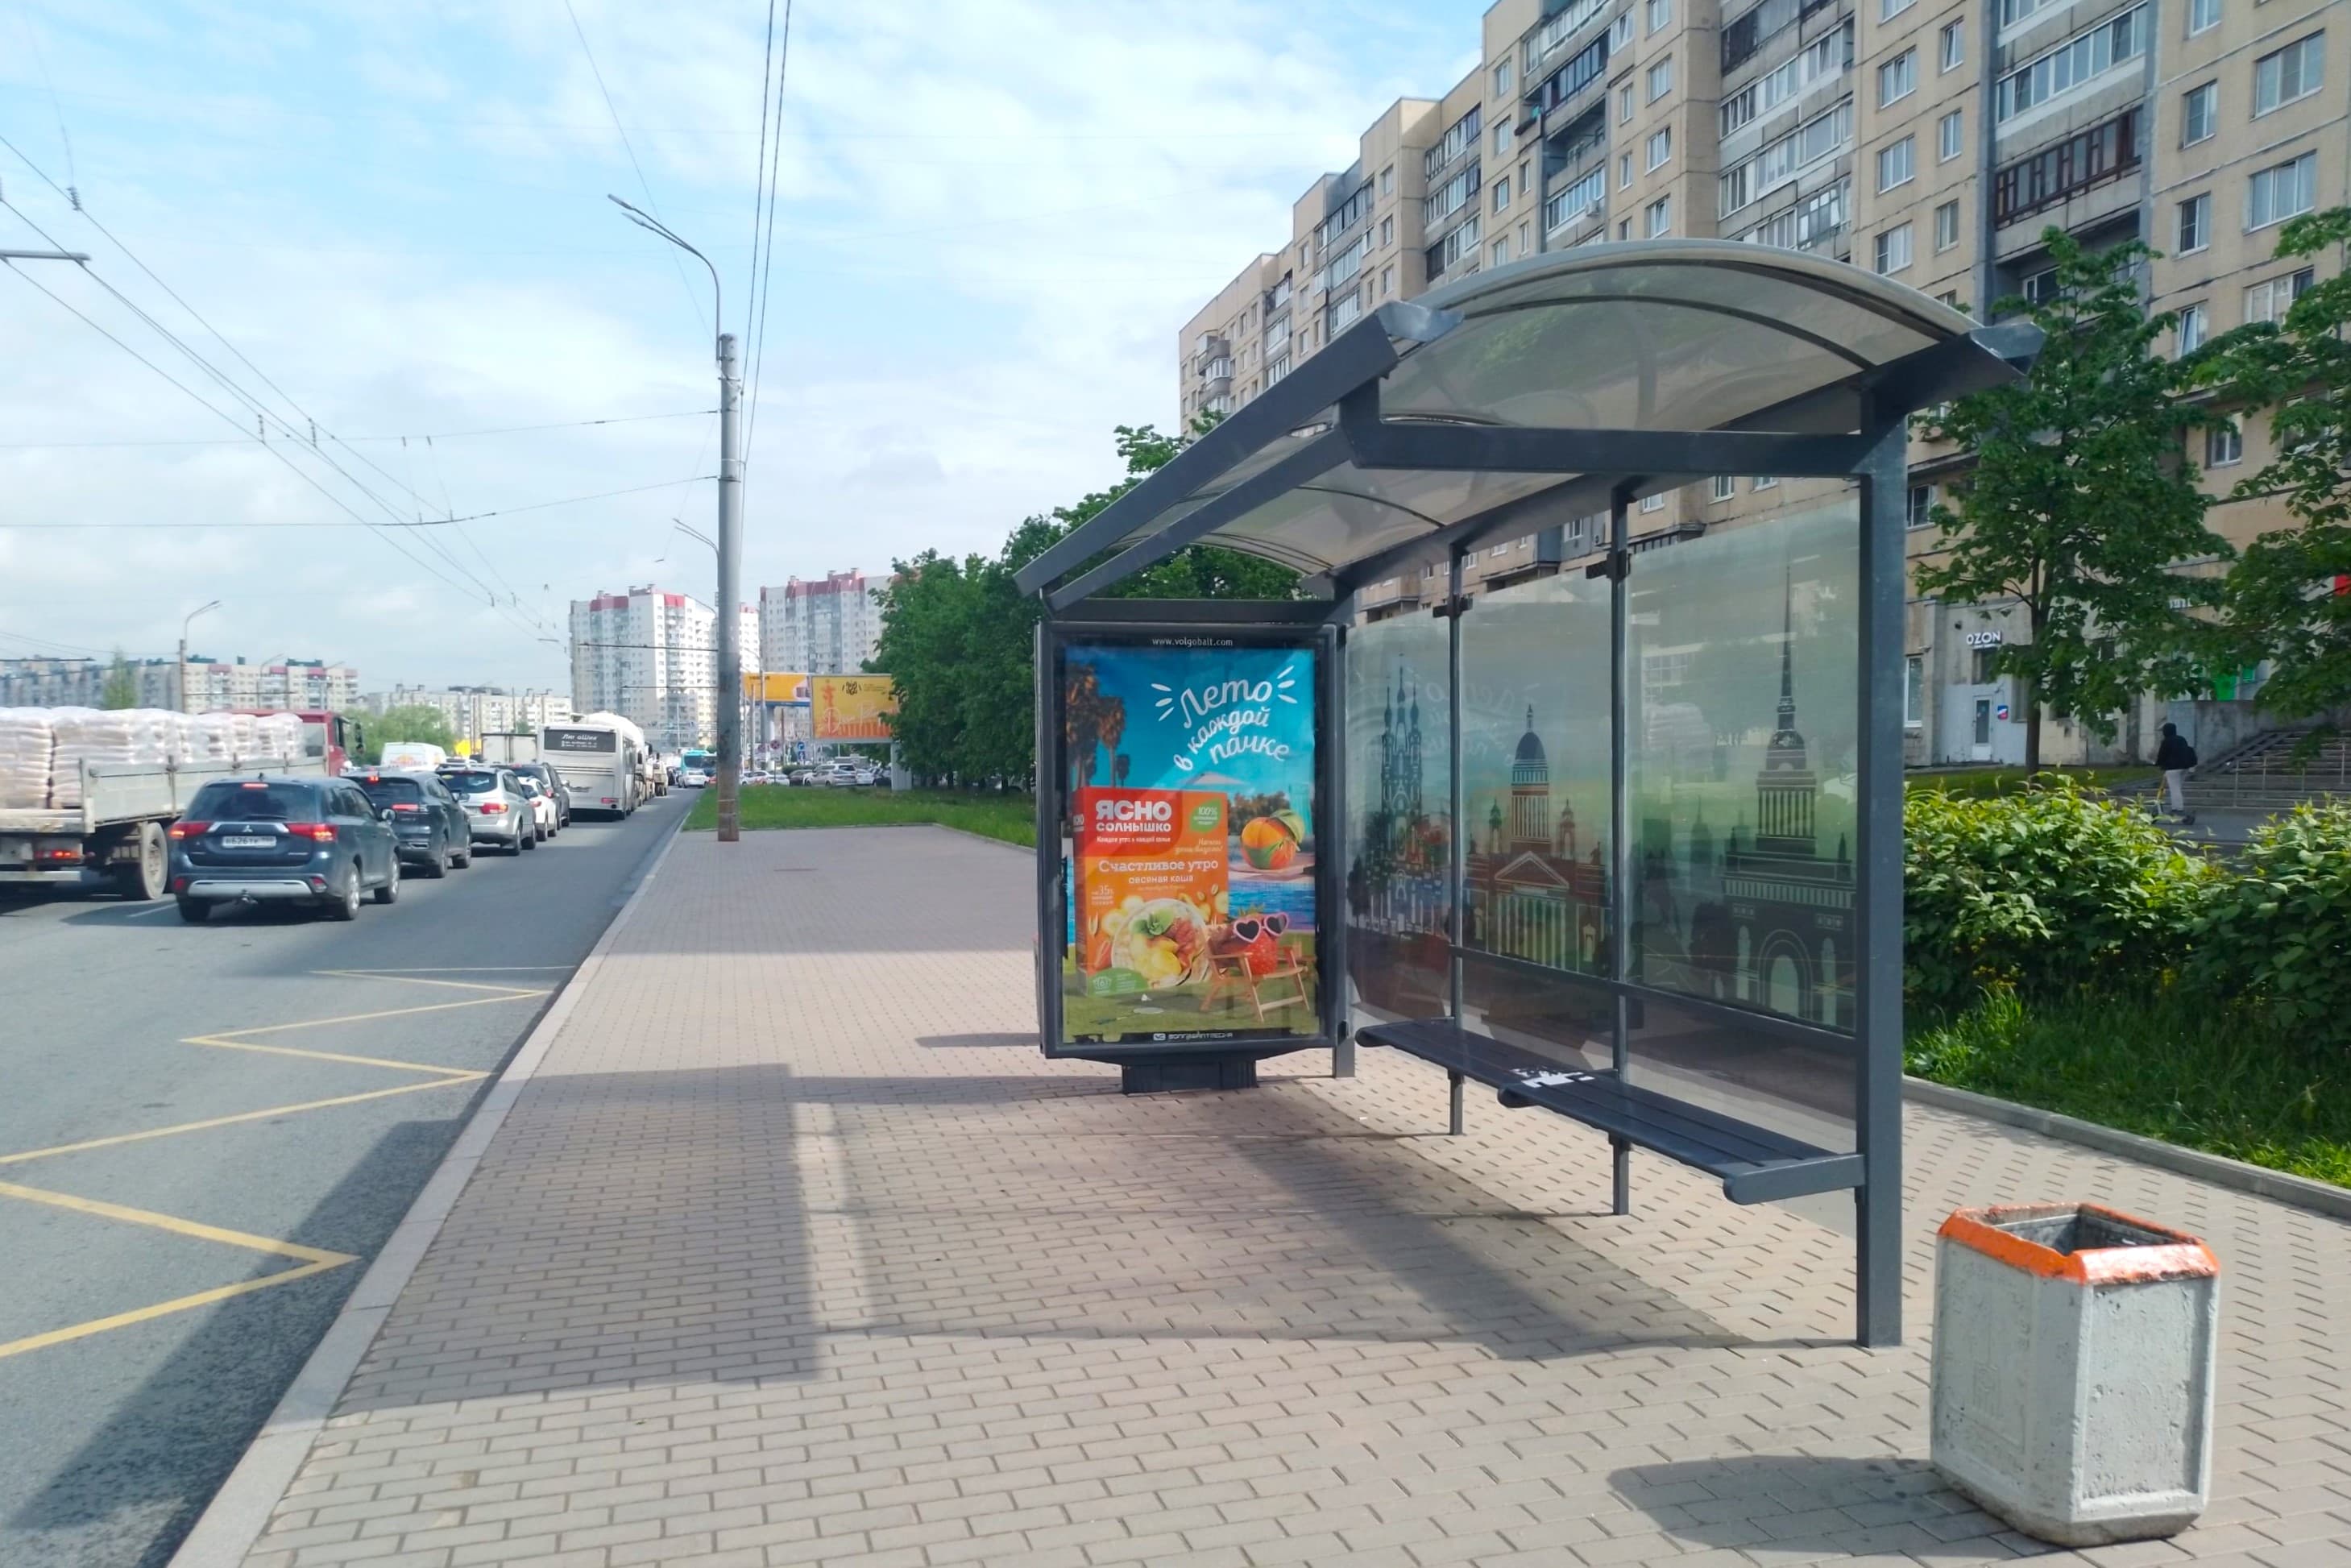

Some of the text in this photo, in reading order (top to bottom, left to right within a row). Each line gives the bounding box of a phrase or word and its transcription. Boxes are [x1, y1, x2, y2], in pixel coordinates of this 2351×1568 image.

[1966, 631, 2002, 645] OZON
[1180, 678, 1273, 728] Лето
[1173, 706, 1271, 771] в каждой
[1210, 735, 1290, 765] пачке
[1096, 799, 1172, 821] ЯСНО
[1098, 860, 1219, 873] Счастливое утро
[1129, 875, 1194, 884] овсяная каша
